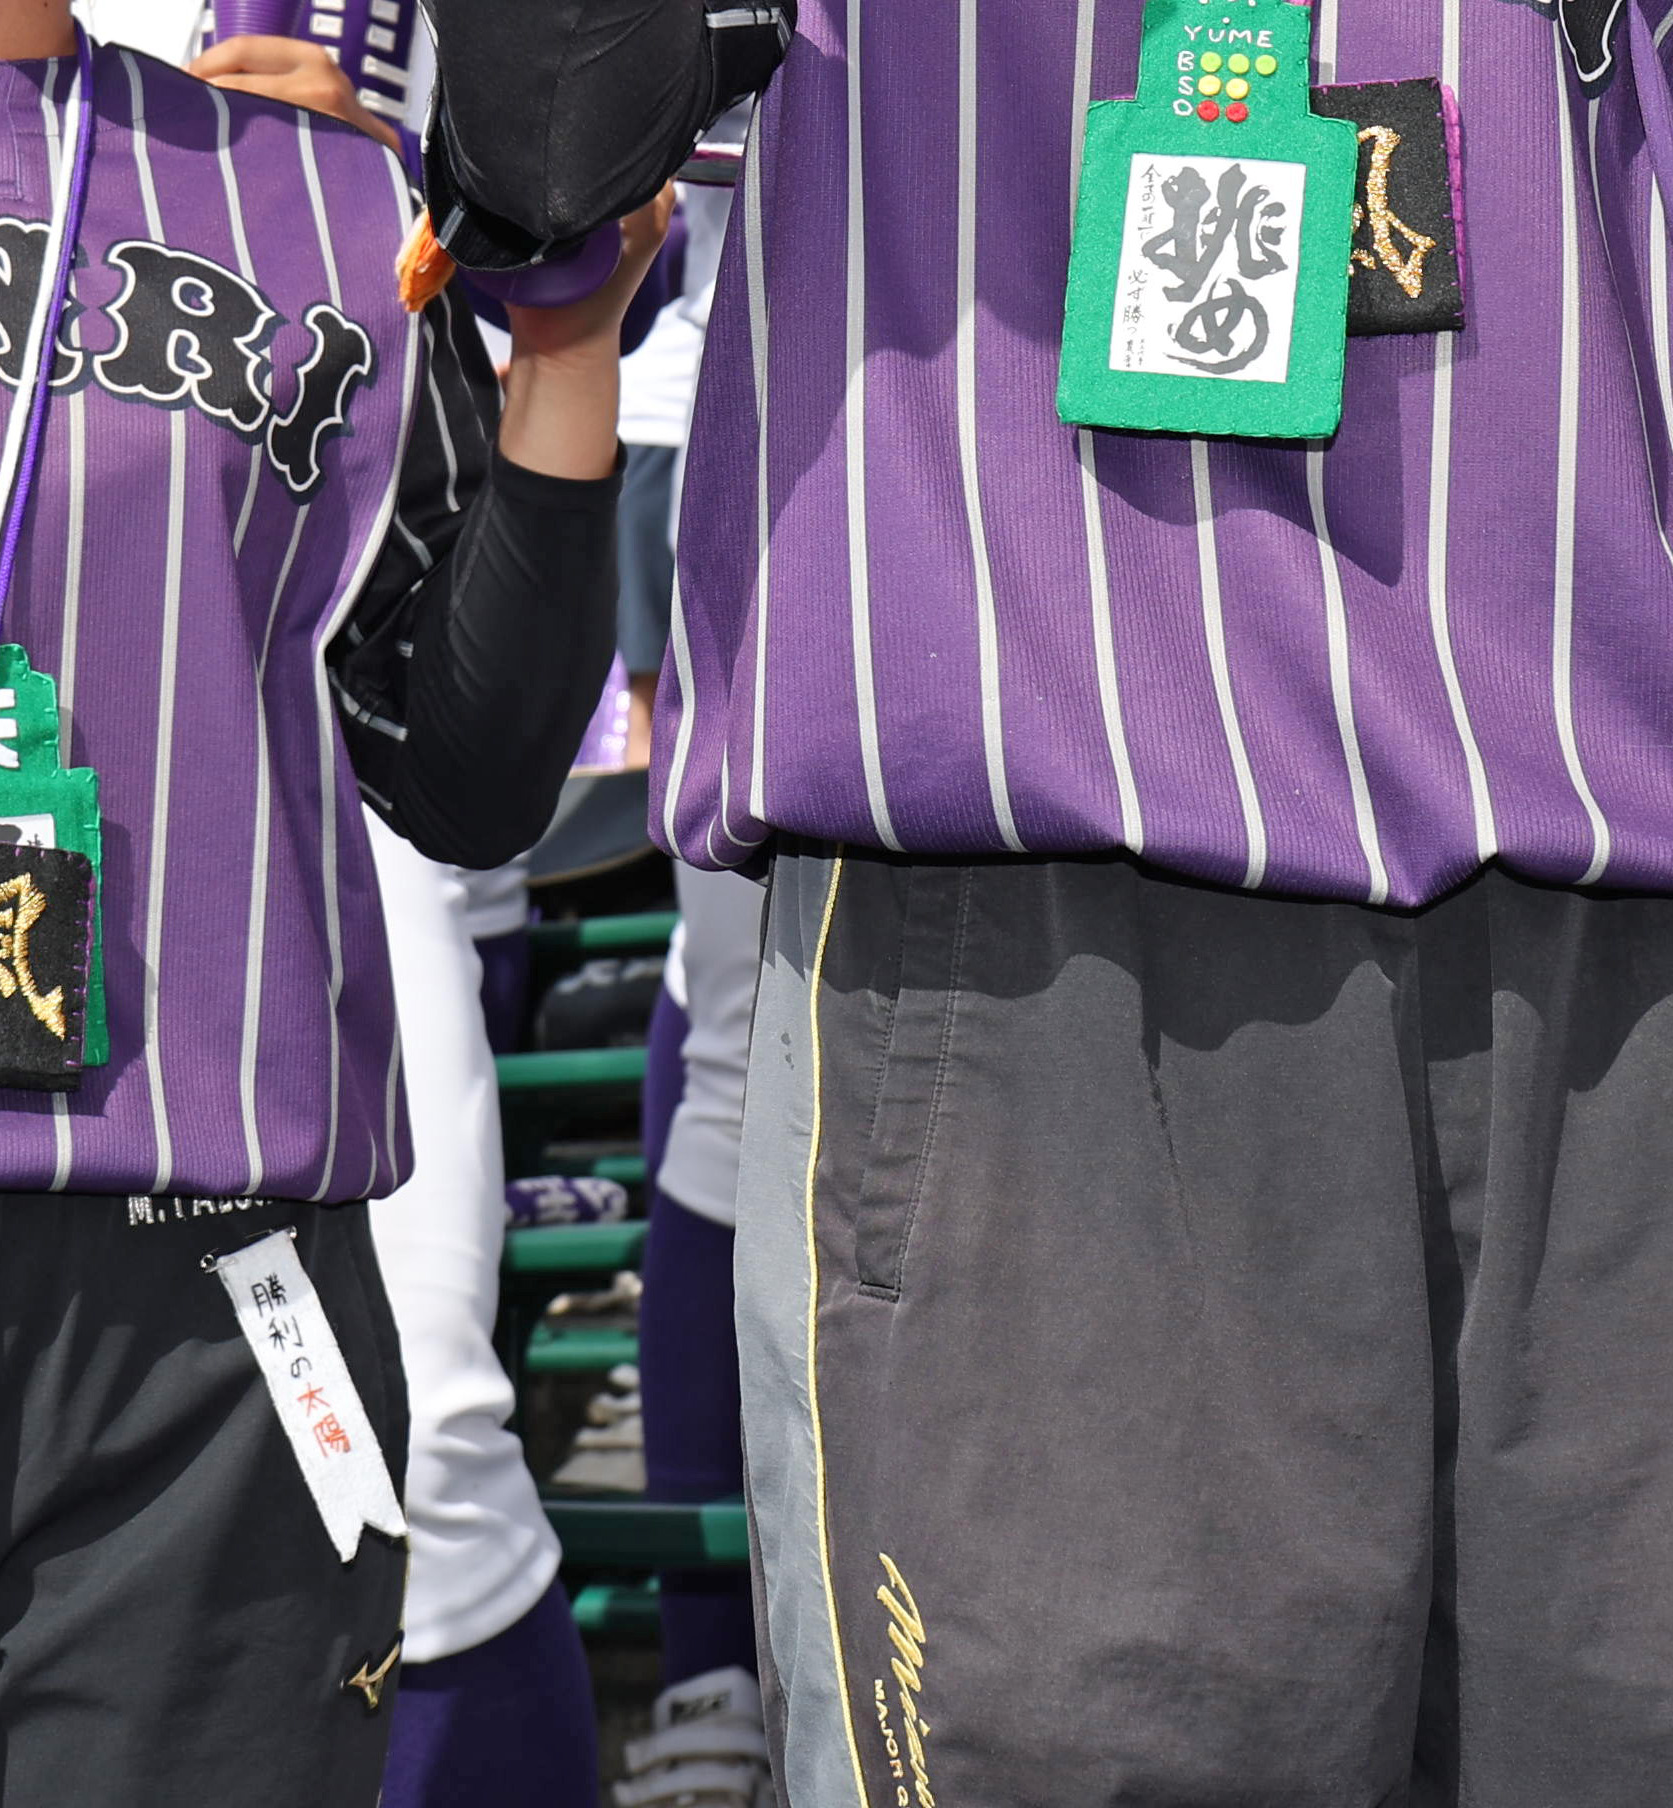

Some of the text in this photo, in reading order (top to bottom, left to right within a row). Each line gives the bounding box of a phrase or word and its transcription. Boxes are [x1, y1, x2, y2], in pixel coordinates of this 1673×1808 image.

[1183, 25, 1274, 49] YUME
[1177, 50, 1195, 71] B
[1177, 76, 1194, 96] S
[875, 1679, 904, 1778] MAJOR
